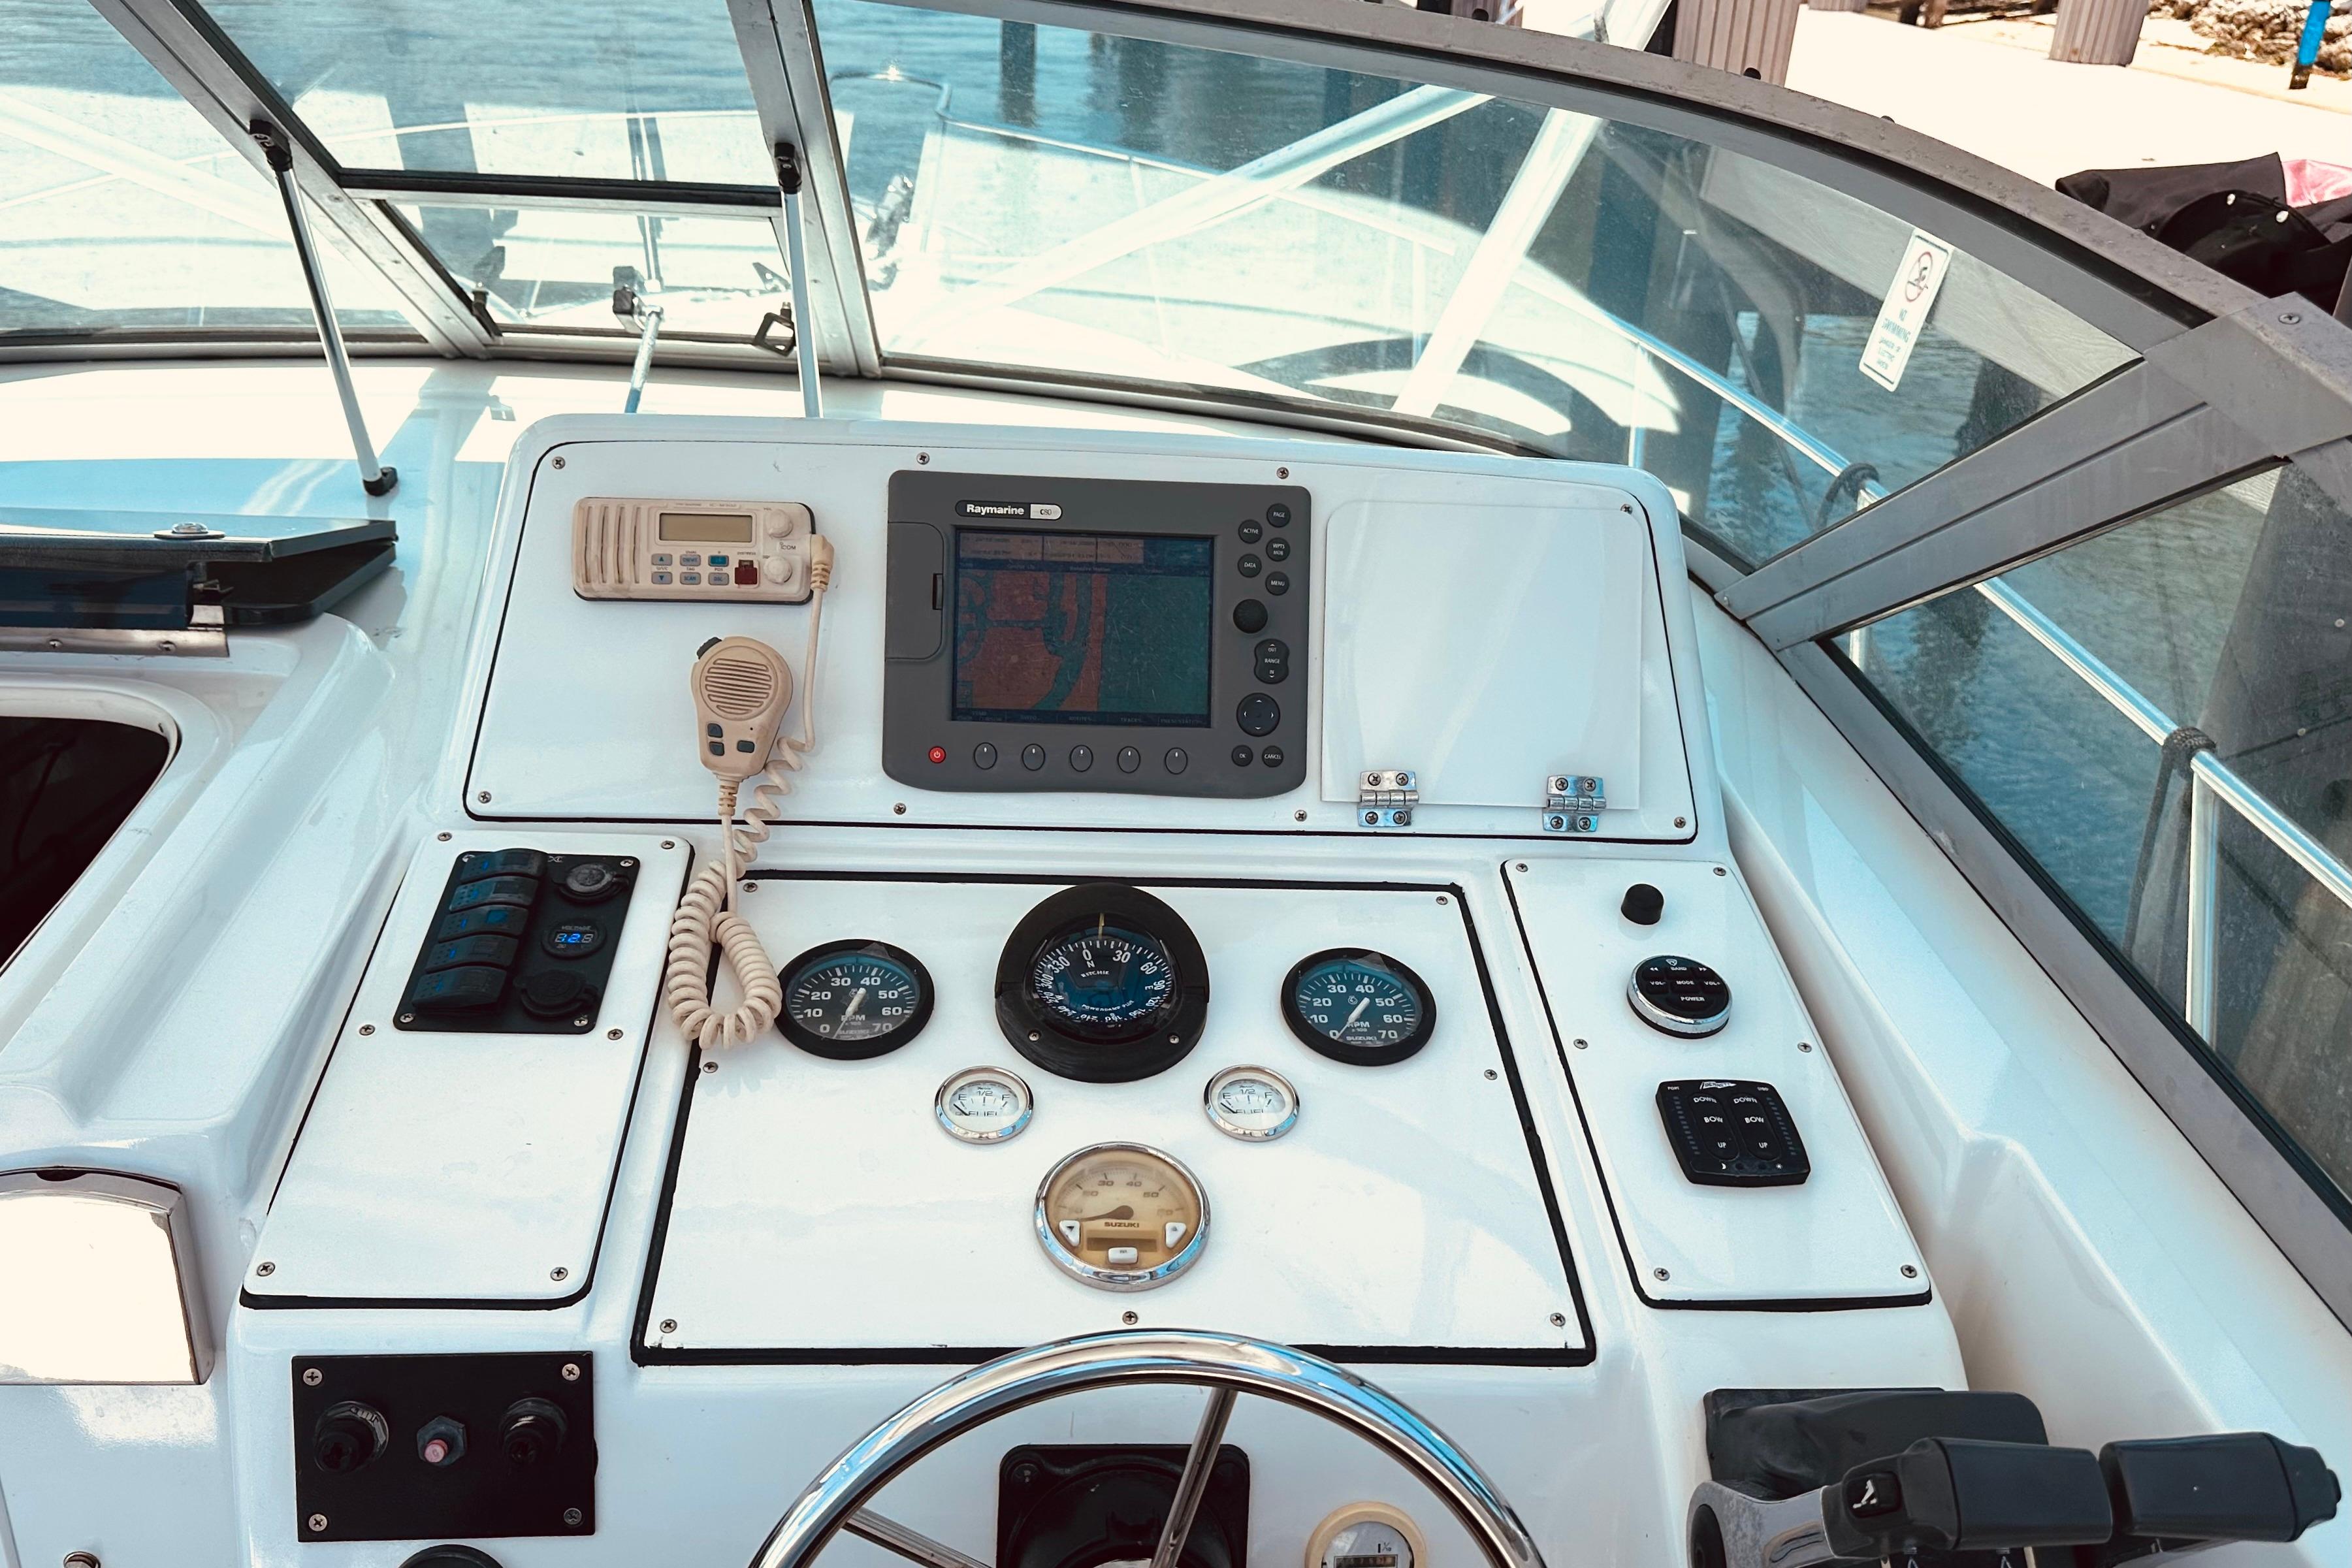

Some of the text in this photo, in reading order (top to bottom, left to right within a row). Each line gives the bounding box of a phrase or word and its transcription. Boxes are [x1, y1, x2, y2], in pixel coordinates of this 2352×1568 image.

[966, 504, 1025, 515] Raymarine
[1082, 948, 1092, 961] 0
[1112, 950, 1131, 963] 30
[1047, 955, 1071, 974] 330
[1086, 960, 1095, 968] N
[1140, 961, 1157, 975] 60
[830, 977, 852, 986] 30
[860, 976, 881, 986] 40
[1040, 973, 1054, 989] 300
[1153, 980, 1166, 991] 90
[1327, 985, 1347, 993] 30
[1355, 985, 1375, 993] 40
[811, 991, 832, 1000] 20
[878, 990, 898, 999] 50
[1312, 998, 1332, 1006] 20
[1375, 998, 1395, 1006] 50
[803, 1008, 823, 1017] 10
[882, 1007, 902, 1016] 60
[1310, 1014, 1329, 1023] 10
[1383, 1014, 1403, 1023] 60
[819, 1023, 830, 1033] 0
[872, 1023, 893, 1032] 70
[1329, 1029, 1340, 1039] 0
[1377, 1030, 1398, 1039] 70
